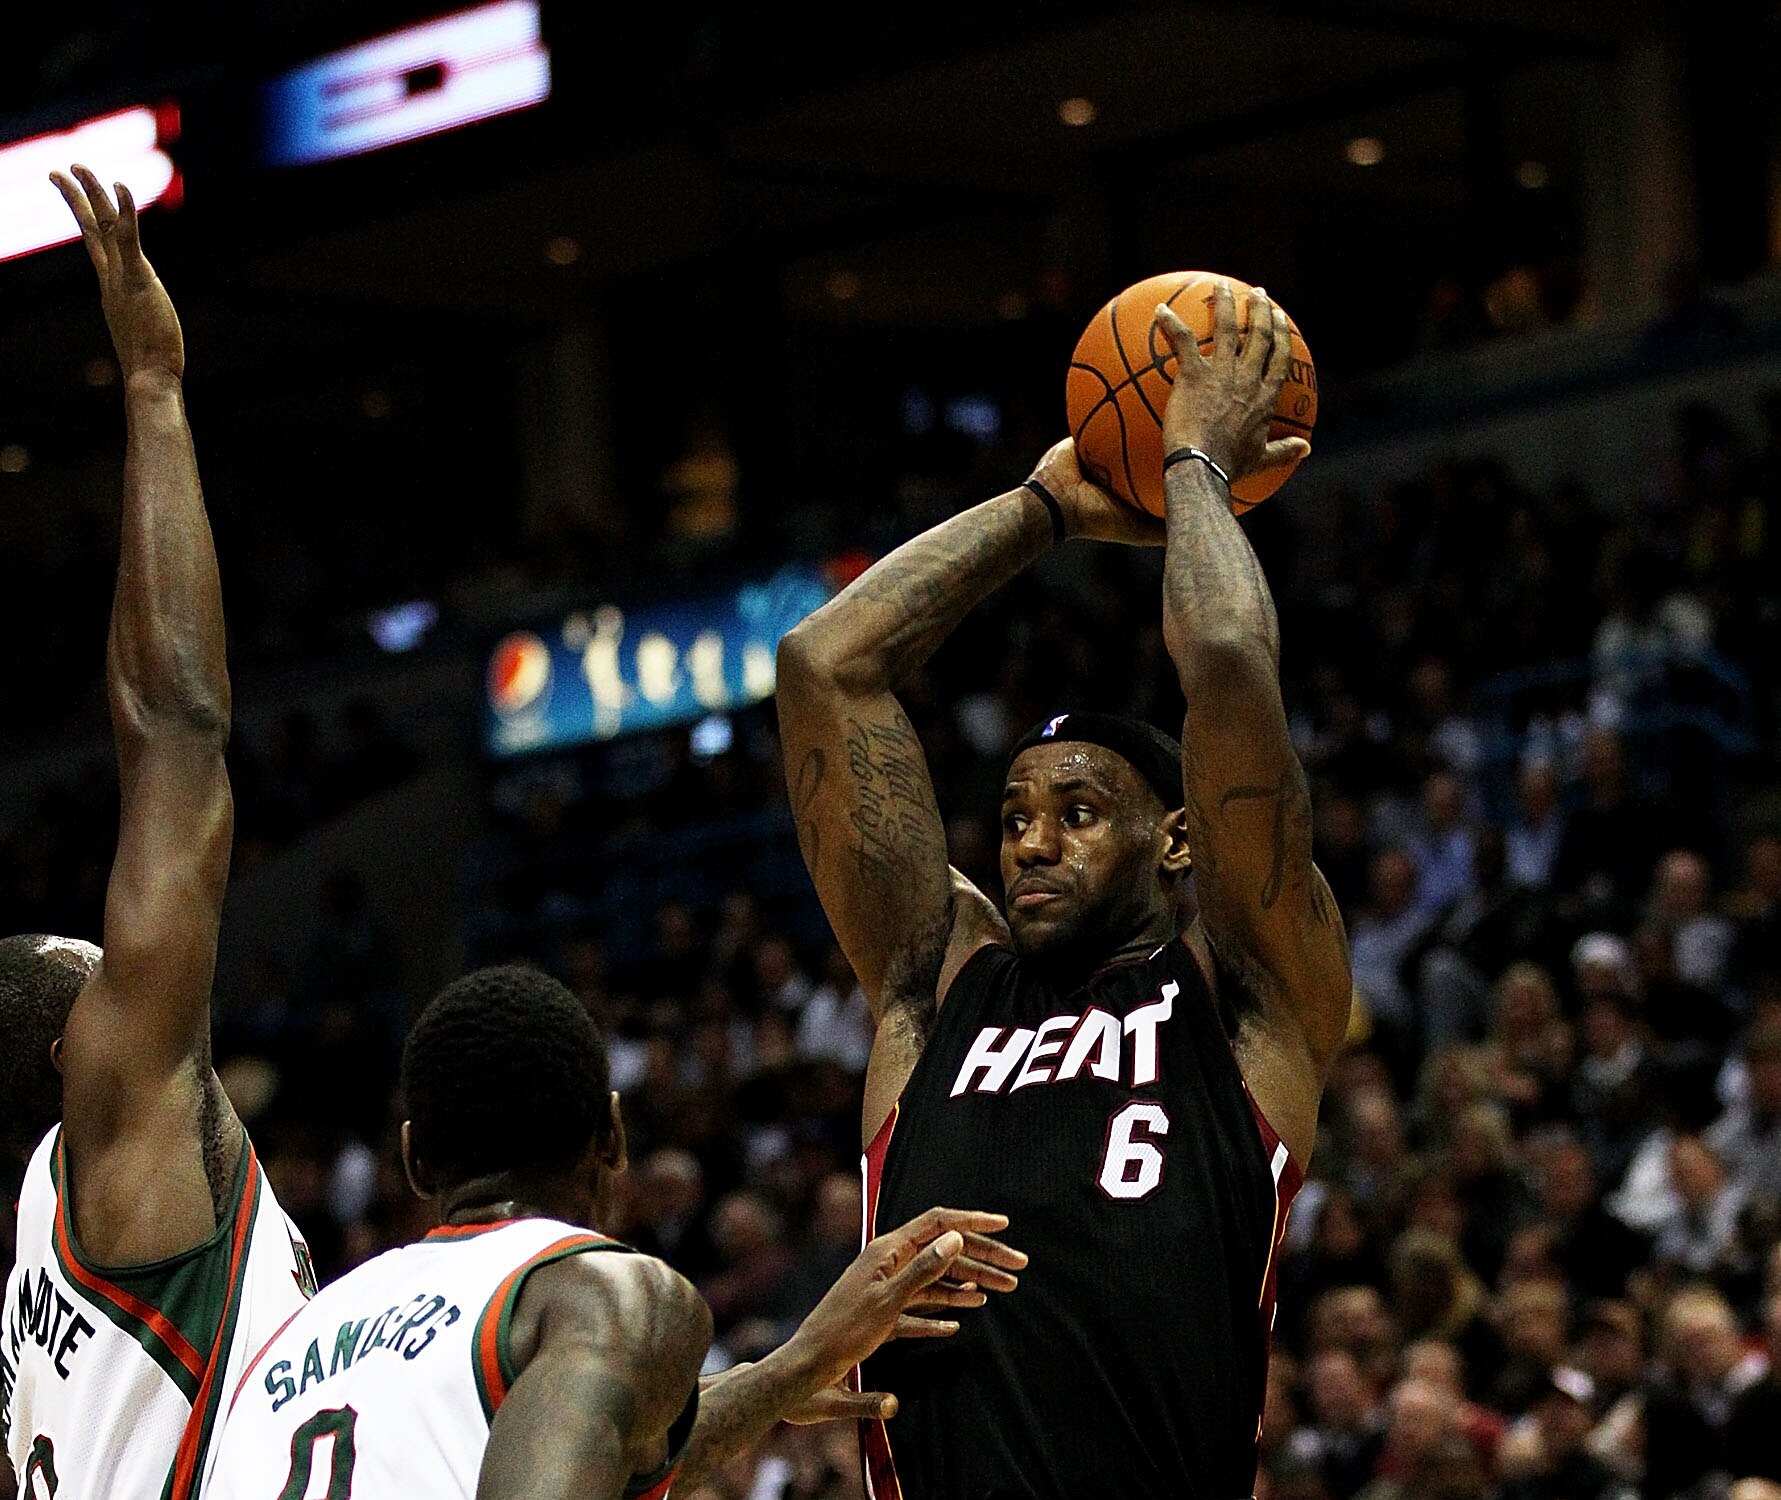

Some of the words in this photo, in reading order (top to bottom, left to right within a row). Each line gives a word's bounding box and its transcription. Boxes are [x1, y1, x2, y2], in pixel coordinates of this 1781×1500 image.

[949, 979, 1181, 1099] HEAT
[1097, 1101, 1170, 1202] 6
[263, 1294, 461, 1413] SANDERS
